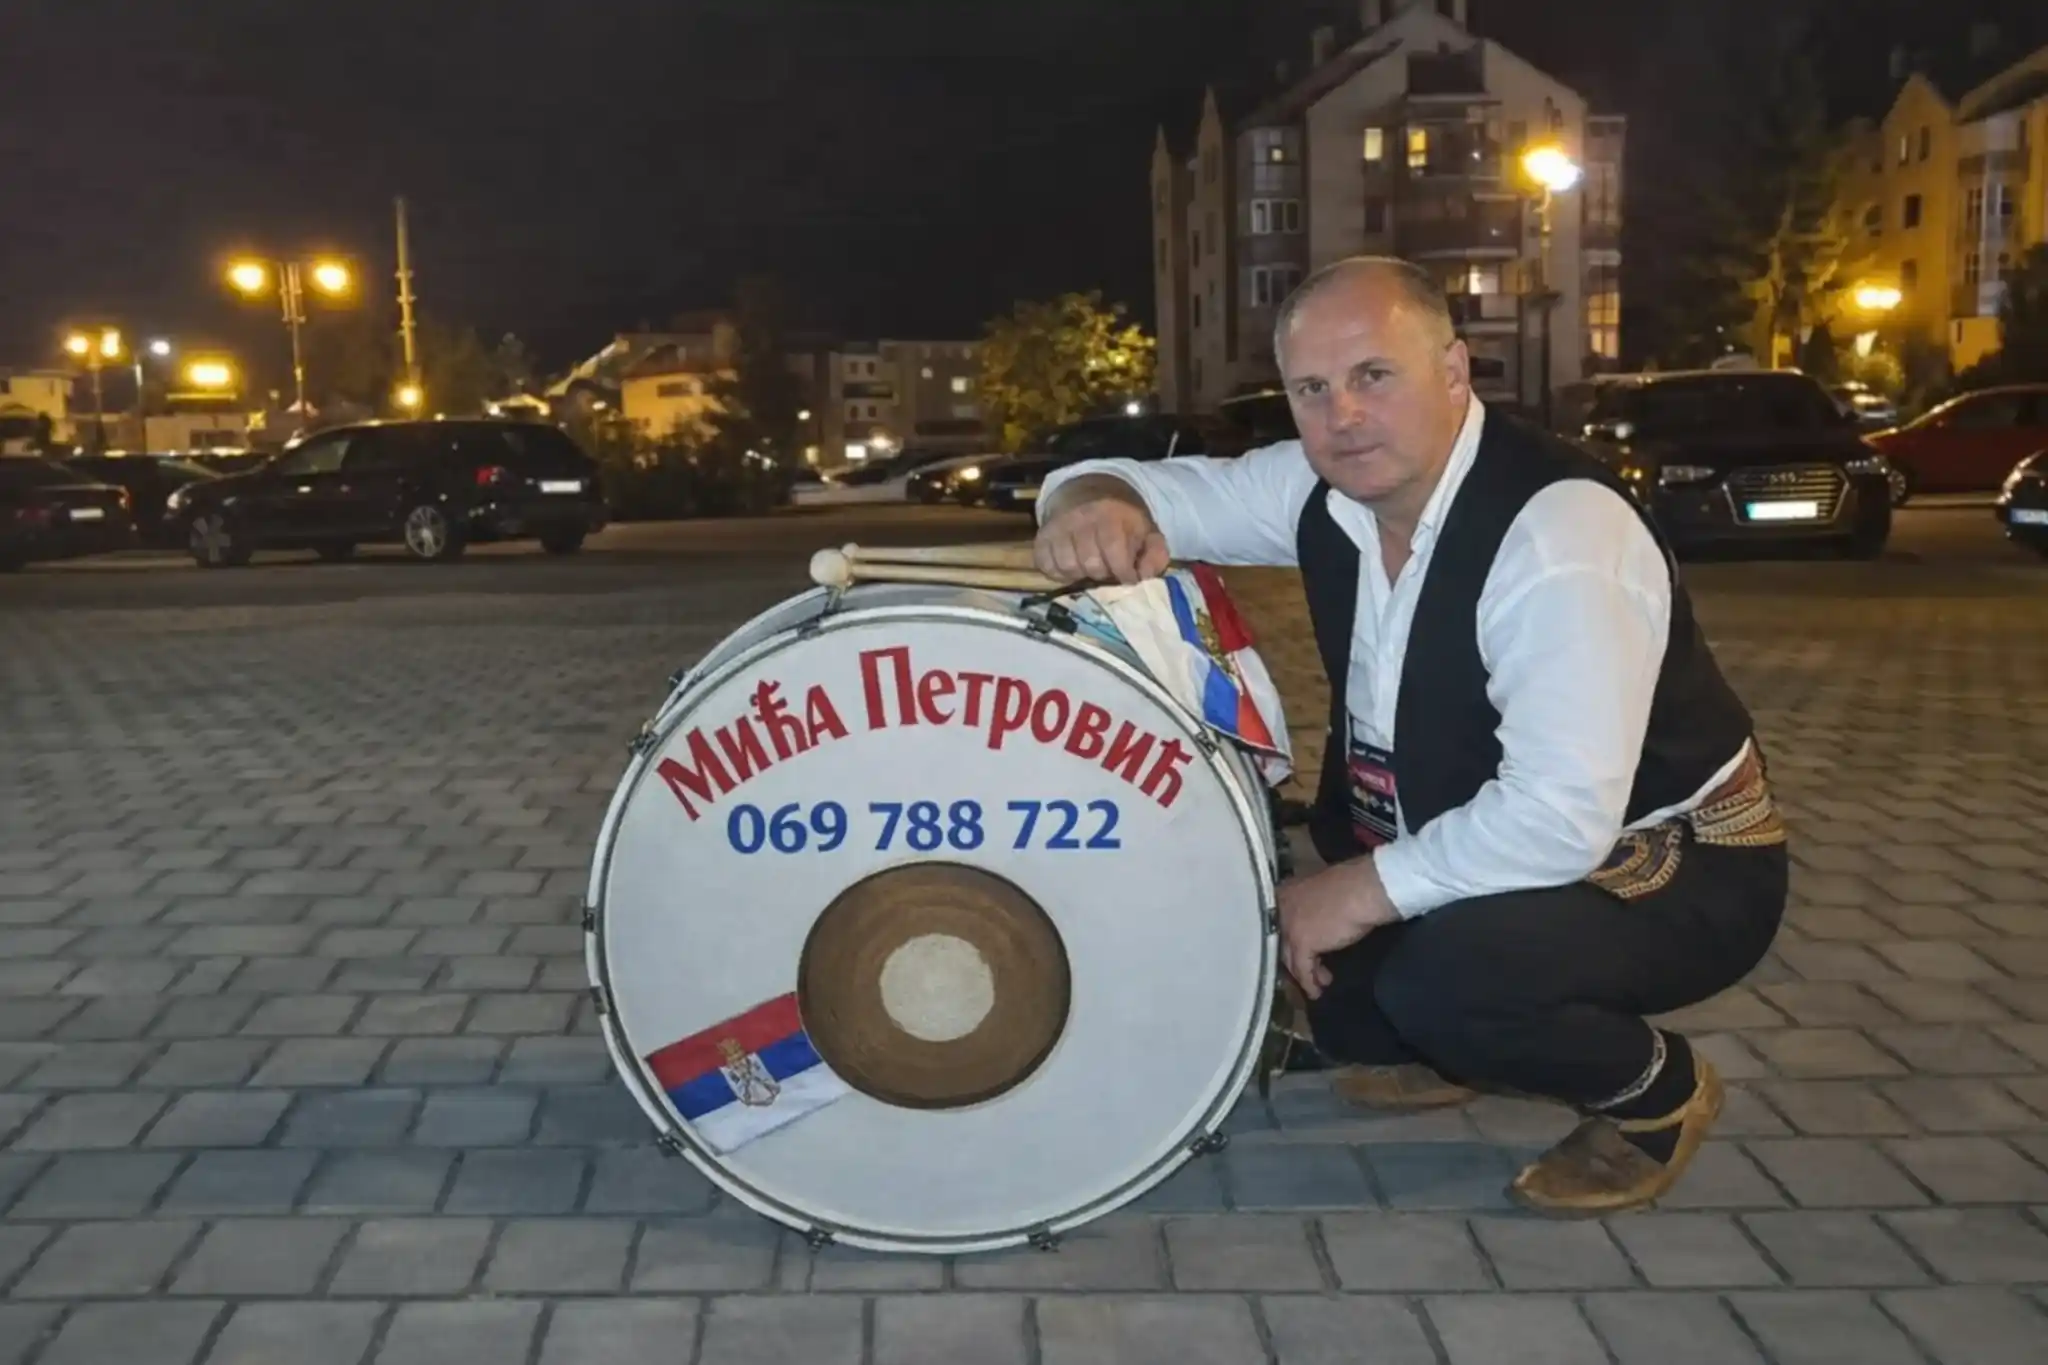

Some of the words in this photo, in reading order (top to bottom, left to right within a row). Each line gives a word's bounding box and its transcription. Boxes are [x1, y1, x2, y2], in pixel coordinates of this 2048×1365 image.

[859, 646, 1194, 808] Петровић
[727, 800, 851, 855] 069
[869, 799, 985, 853] 788
[1006, 798, 1122, 853] 722
